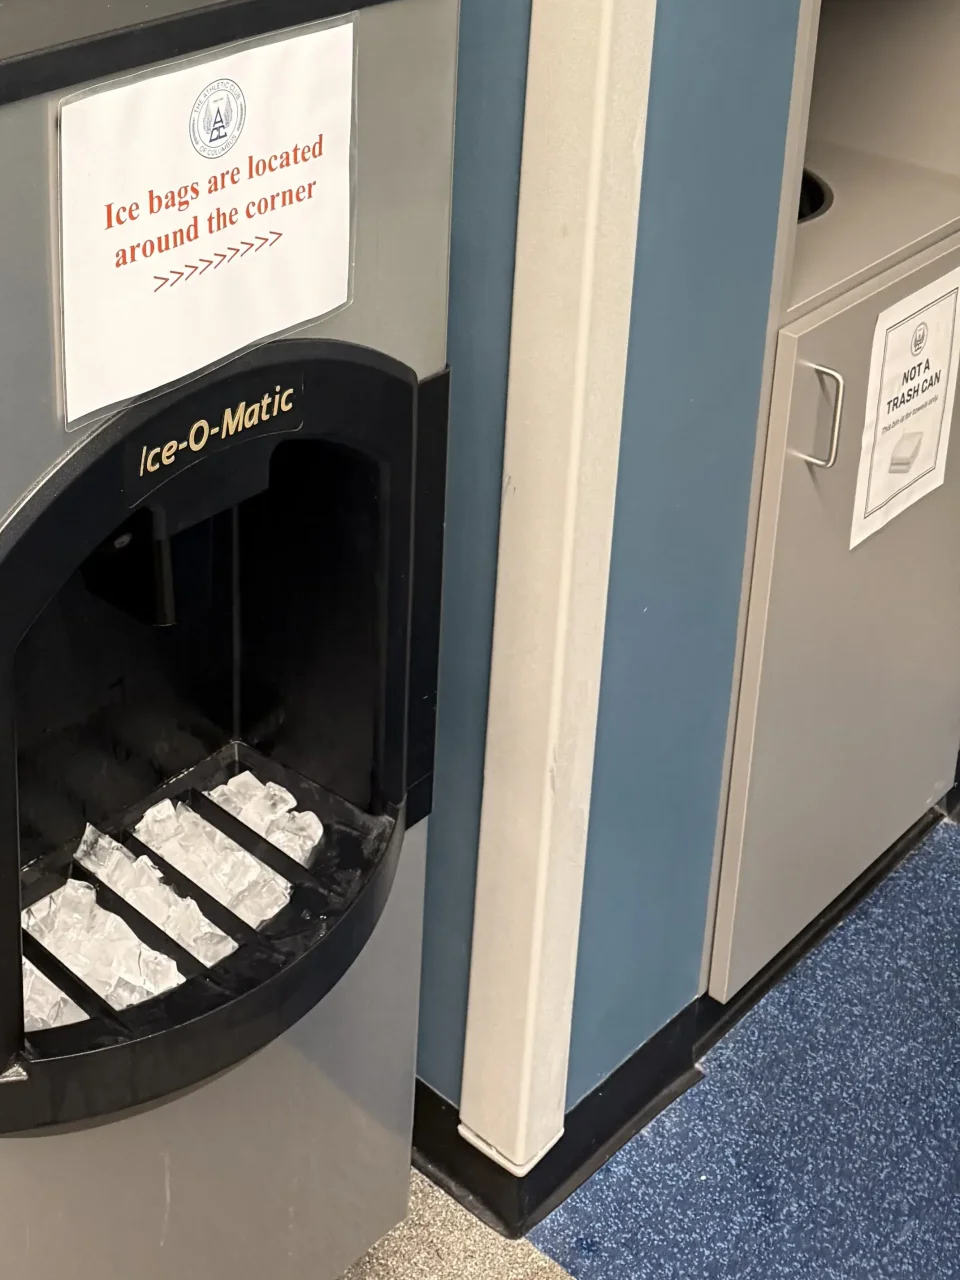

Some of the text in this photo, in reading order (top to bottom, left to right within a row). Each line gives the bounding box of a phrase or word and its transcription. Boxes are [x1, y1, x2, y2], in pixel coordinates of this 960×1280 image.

[203, 81, 230, 98] ATHLETIC
[199, 134, 237, 156] OF COLUMBUS
[104, 134, 324, 230] Ice bags are located
[115, 179, 317, 269] around the corner
[886, 369, 942, 415] TRASH CAN
[901, 358, 930, 386] NOT A
[139, 384, 295, 477] Ice-O-Matic
